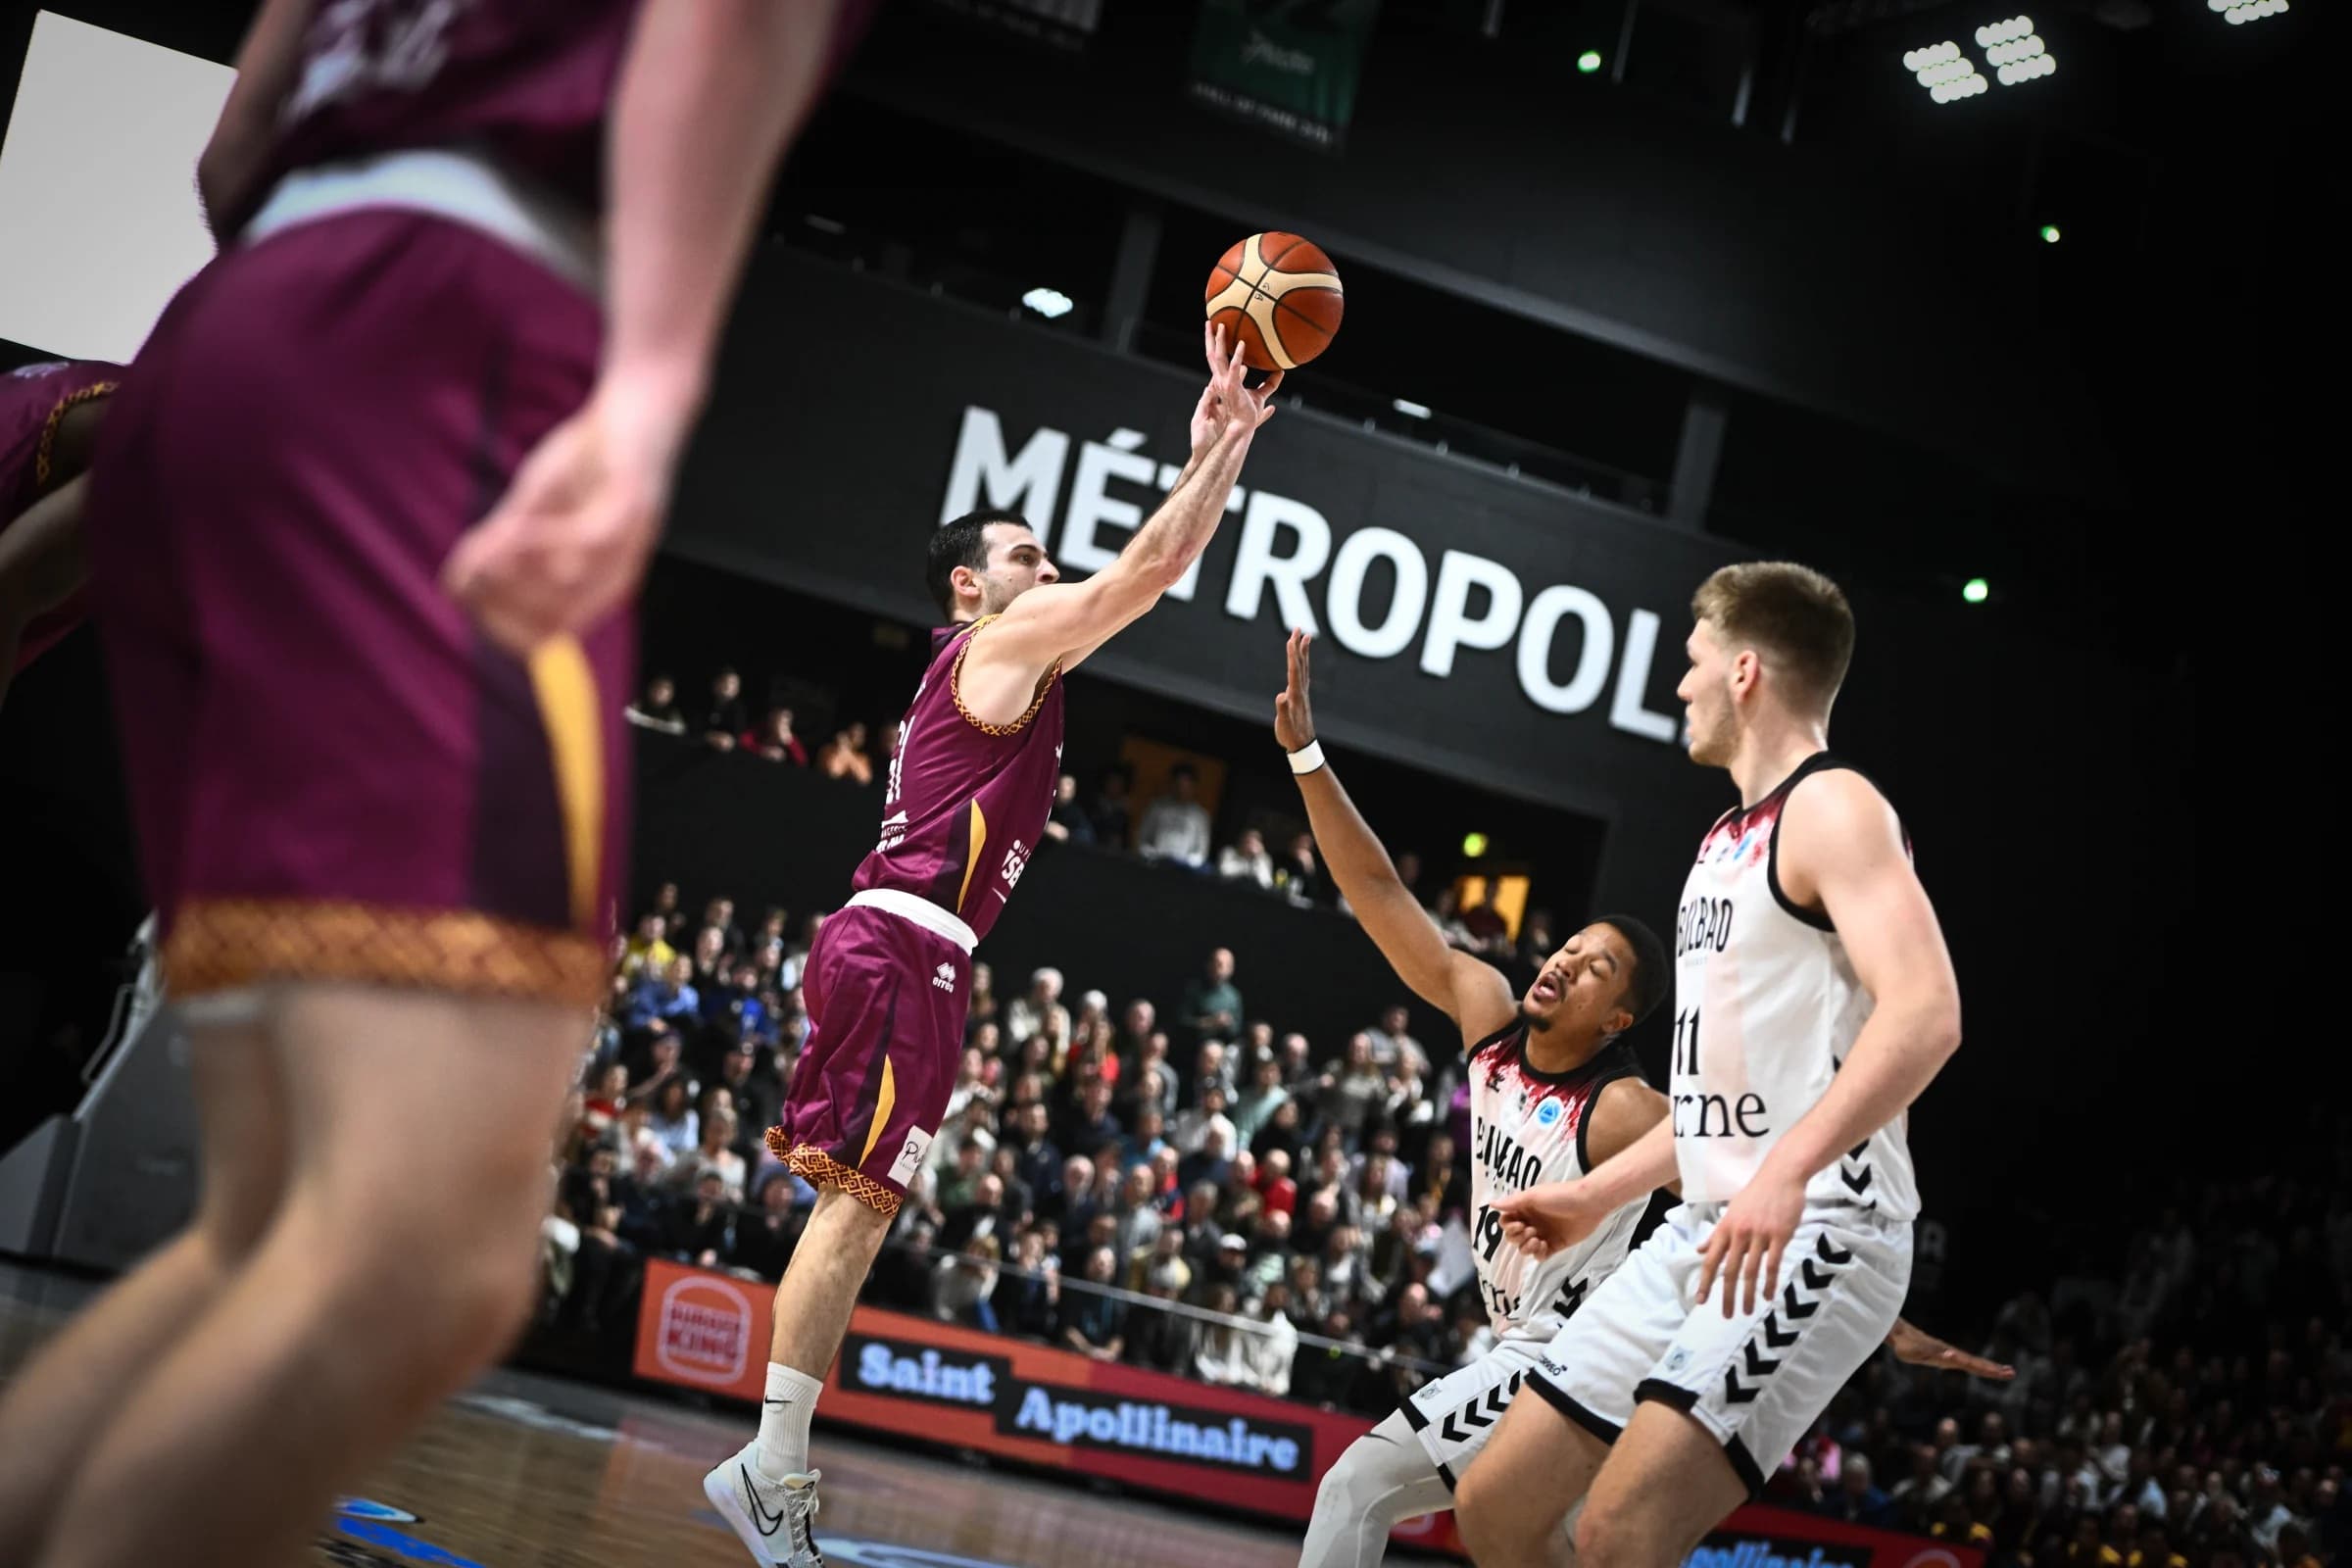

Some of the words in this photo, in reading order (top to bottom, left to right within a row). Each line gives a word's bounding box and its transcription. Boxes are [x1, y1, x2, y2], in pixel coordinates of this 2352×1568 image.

[939, 405, 1692, 749] MÉROPOL
[1677, 1005, 1700, 1076] 11
[1473, 1204, 1504, 1262] 19
[857, 1343, 996, 1404] Saint
[1015, 1387, 1299, 1470] Apollinaire
